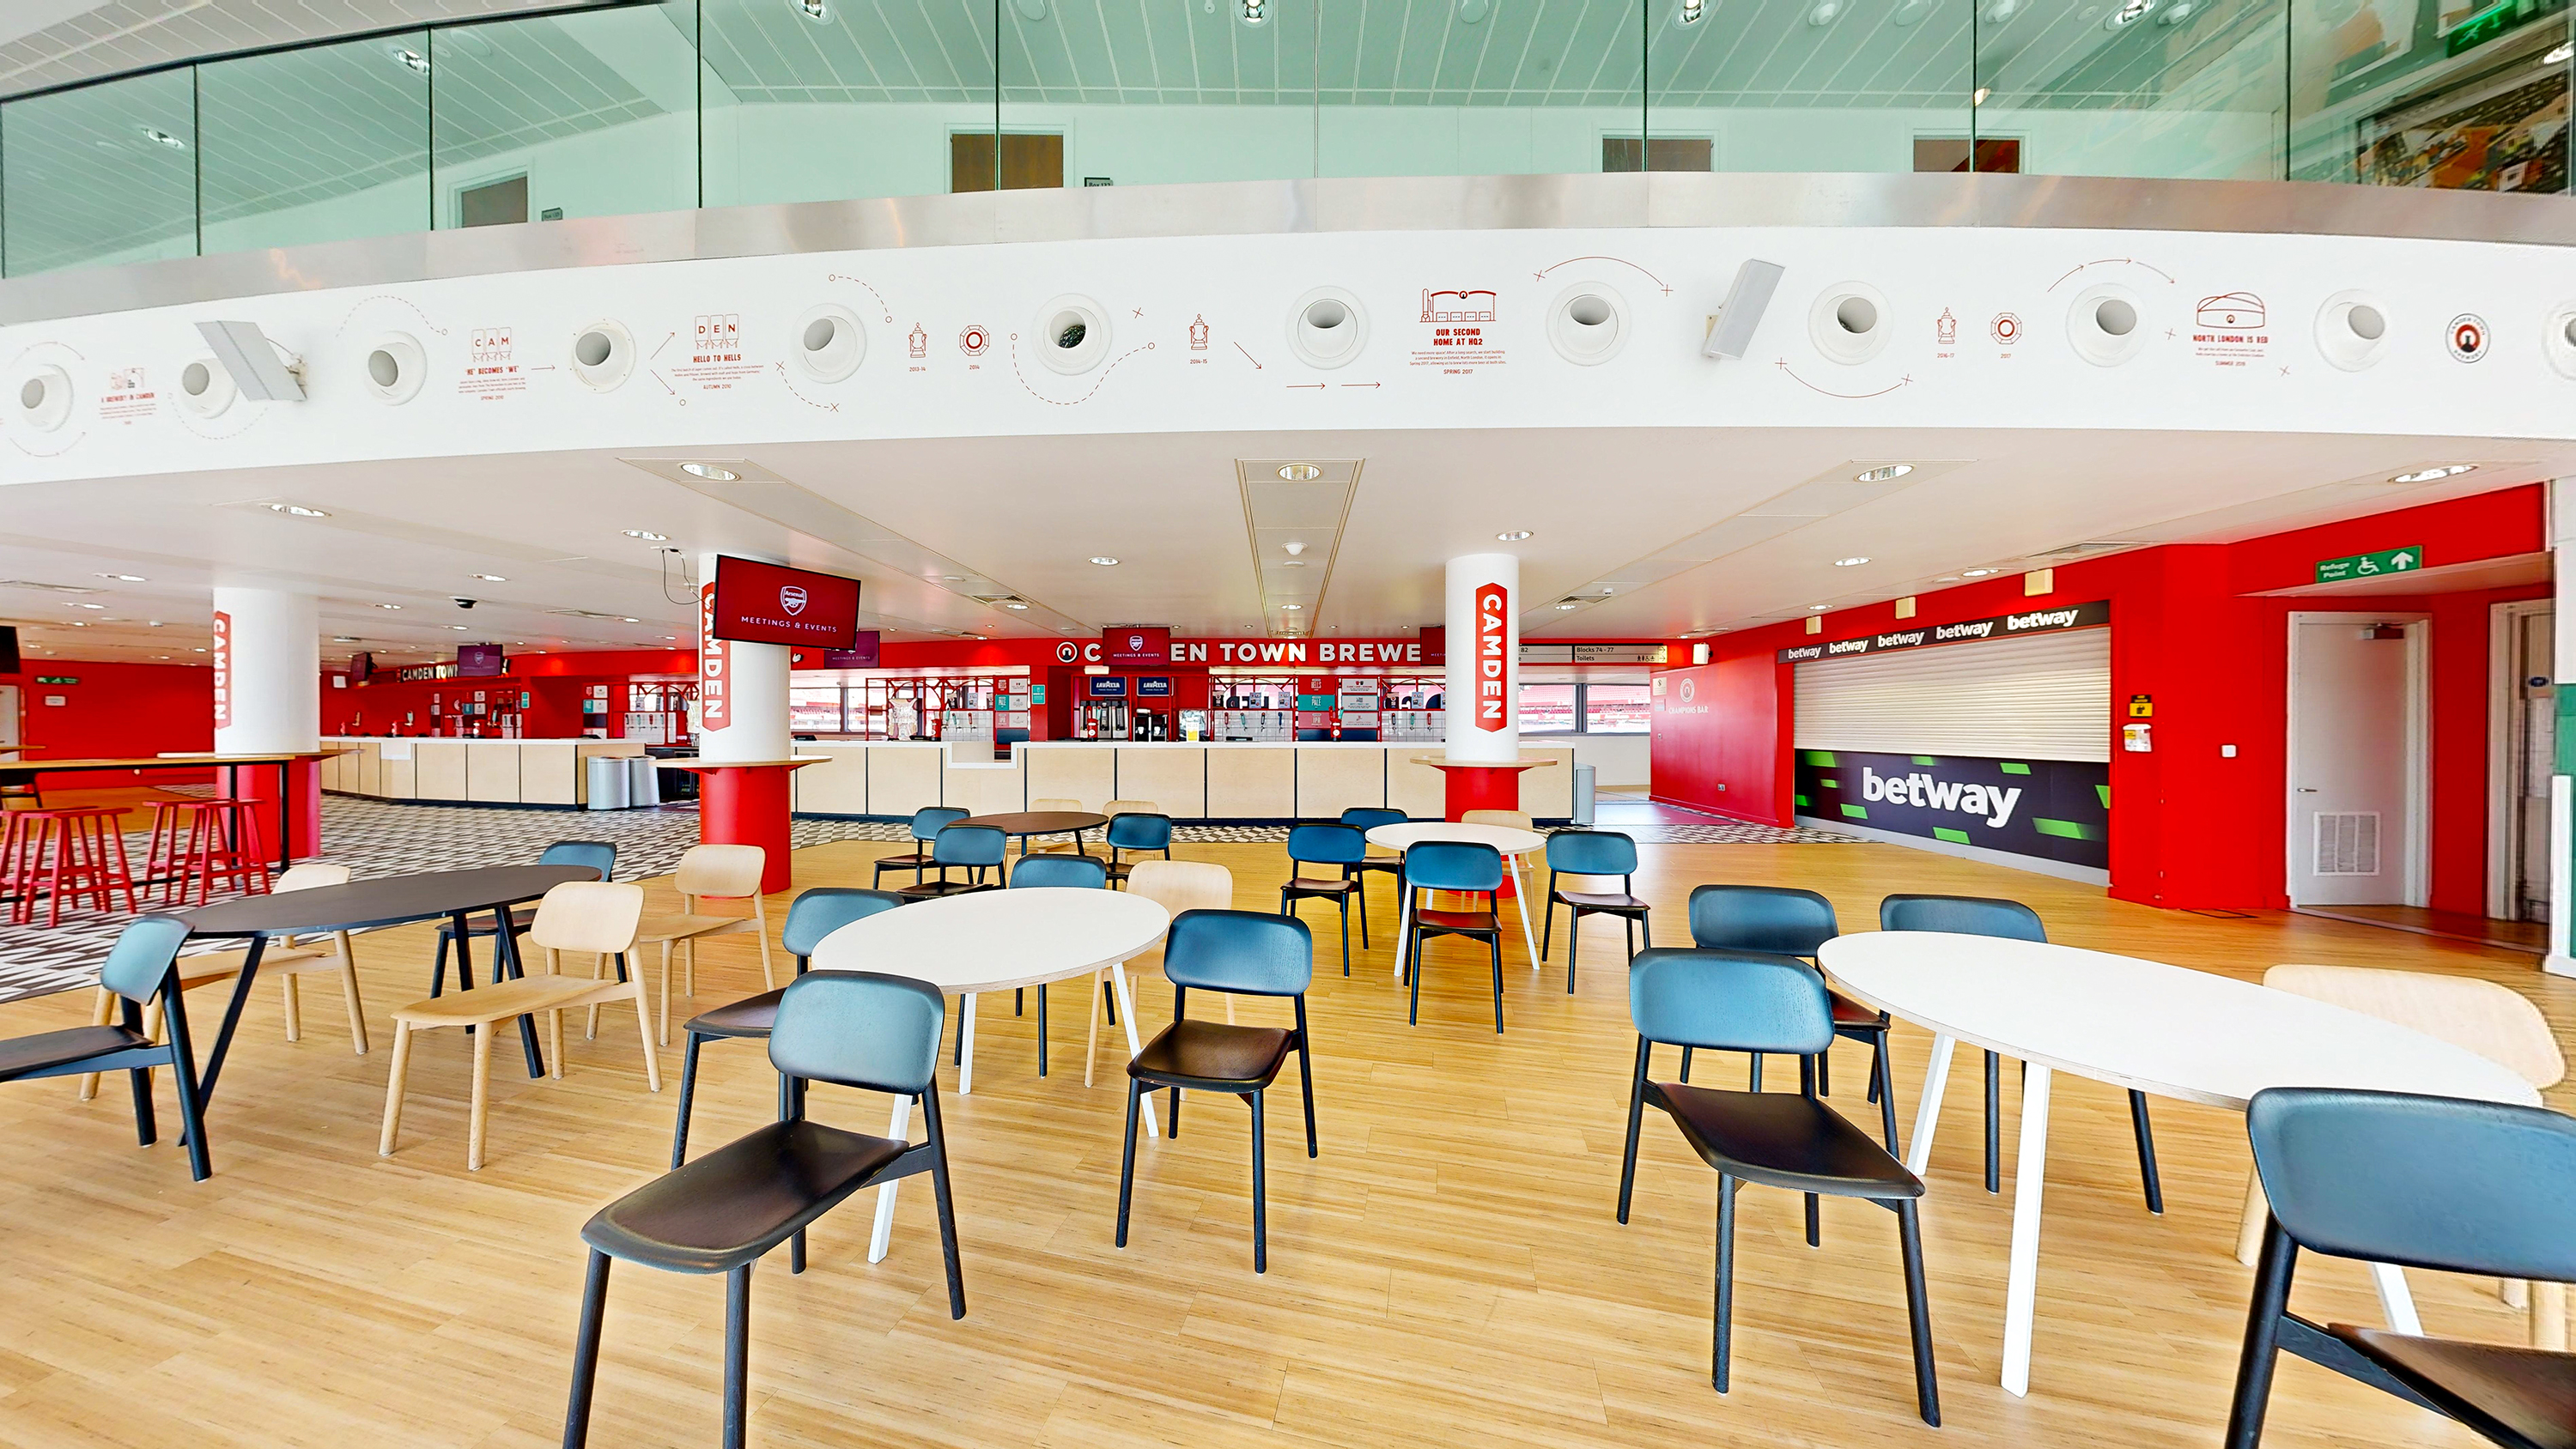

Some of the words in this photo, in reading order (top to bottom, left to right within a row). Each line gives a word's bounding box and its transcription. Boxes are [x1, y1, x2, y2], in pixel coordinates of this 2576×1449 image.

[1436, 328, 1450, 336] OUR
[1468, 337, 1483, 346] HQ2
[478, 367, 504, 375] BECOMES
[2320, 562, 2350, 572] Refuge
[2323, 570, 2347, 579] Point
[741, 615, 791, 627] MEETINGS
[805, 623, 837, 633] EVENTS
[1788, 646, 1822, 659] betway
[1829, 639, 1868, 654] betway
[1877, 630, 1925, 648] betway
[1935, 620, 1994, 640] betway
[2007, 609, 2079, 631] betway
[1084, 643, 1206, 662] CEN
[1220, 643, 1306, 662] TOWN
[1320, 643, 1420, 662] BREWE
[1483, 593, 1502, 718] CAMDEN
[214, 619, 227, 719] CAMDEN
[402, 666, 434, 681] CAMDEN
[1862, 767, 2021, 828] betway
